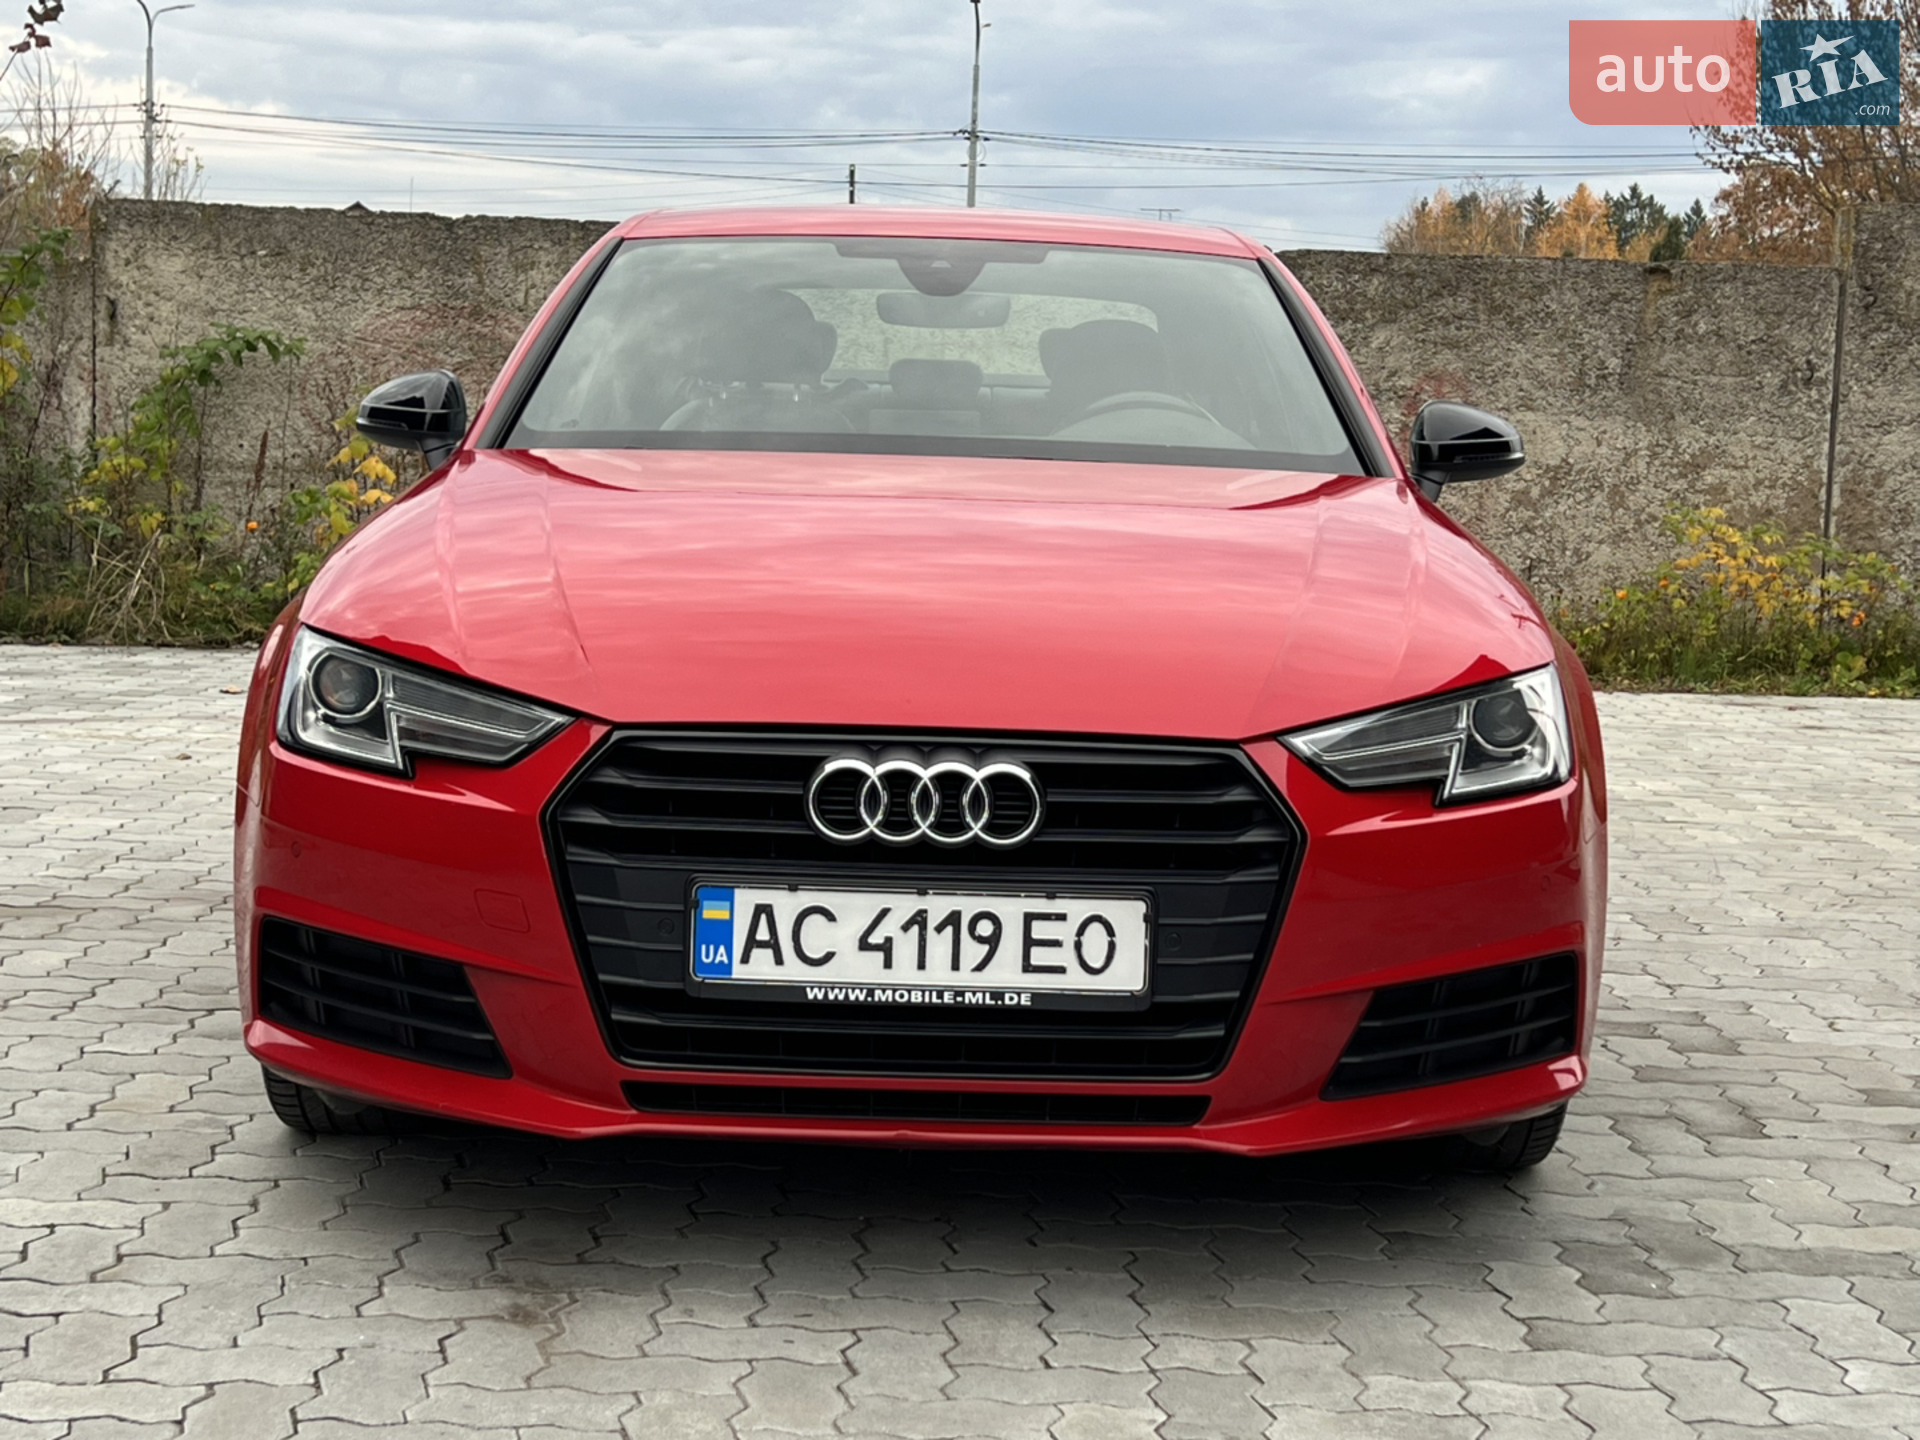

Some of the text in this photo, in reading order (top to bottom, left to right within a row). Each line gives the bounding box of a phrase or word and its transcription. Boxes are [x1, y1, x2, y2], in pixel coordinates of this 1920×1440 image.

[739, 903, 1117, 976] AC 4119 EO
[701, 944, 729, 965] UA
[805, 986, 1033, 1006] WWW.MOBILE-ML.DE
